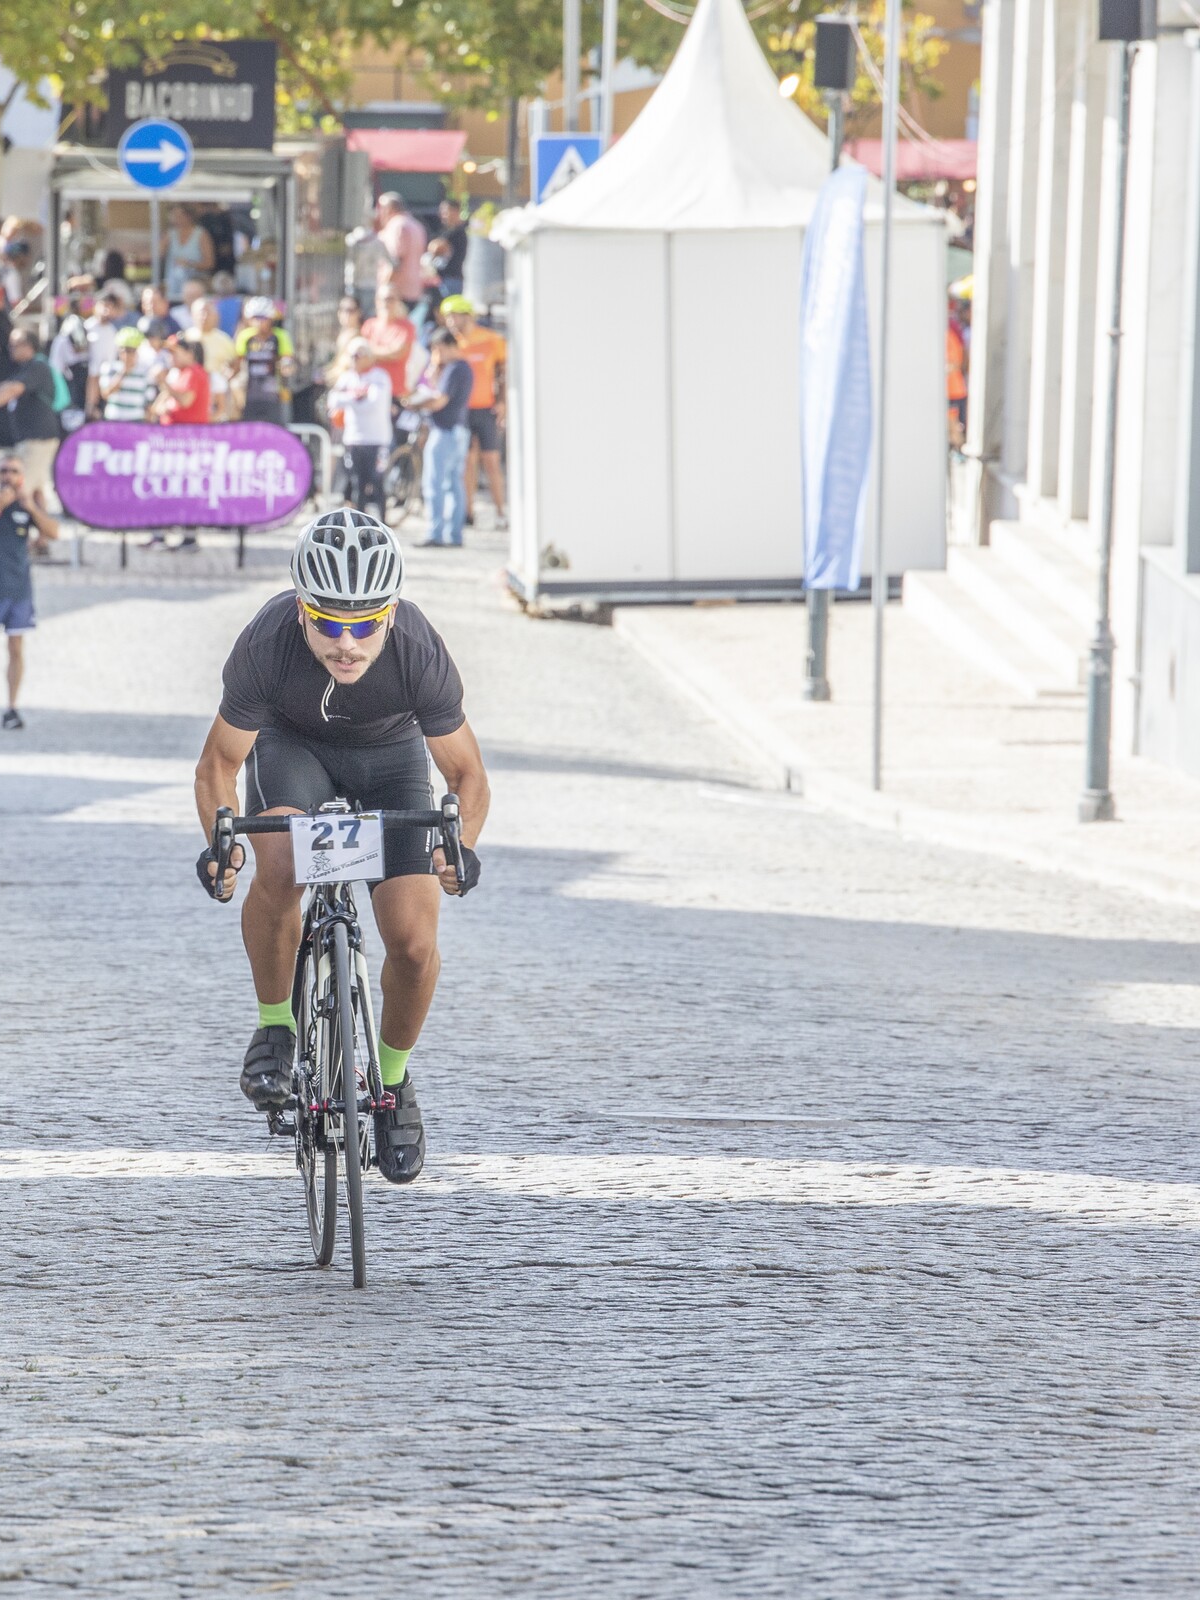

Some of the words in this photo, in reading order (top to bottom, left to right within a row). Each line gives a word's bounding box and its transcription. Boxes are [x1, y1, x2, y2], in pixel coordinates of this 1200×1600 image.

[124, 80, 253, 121] BACORINHO
[74, 440, 257, 476] Palmela
[132, 470, 296, 511] conquista
[310, 820, 362, 851] 27
